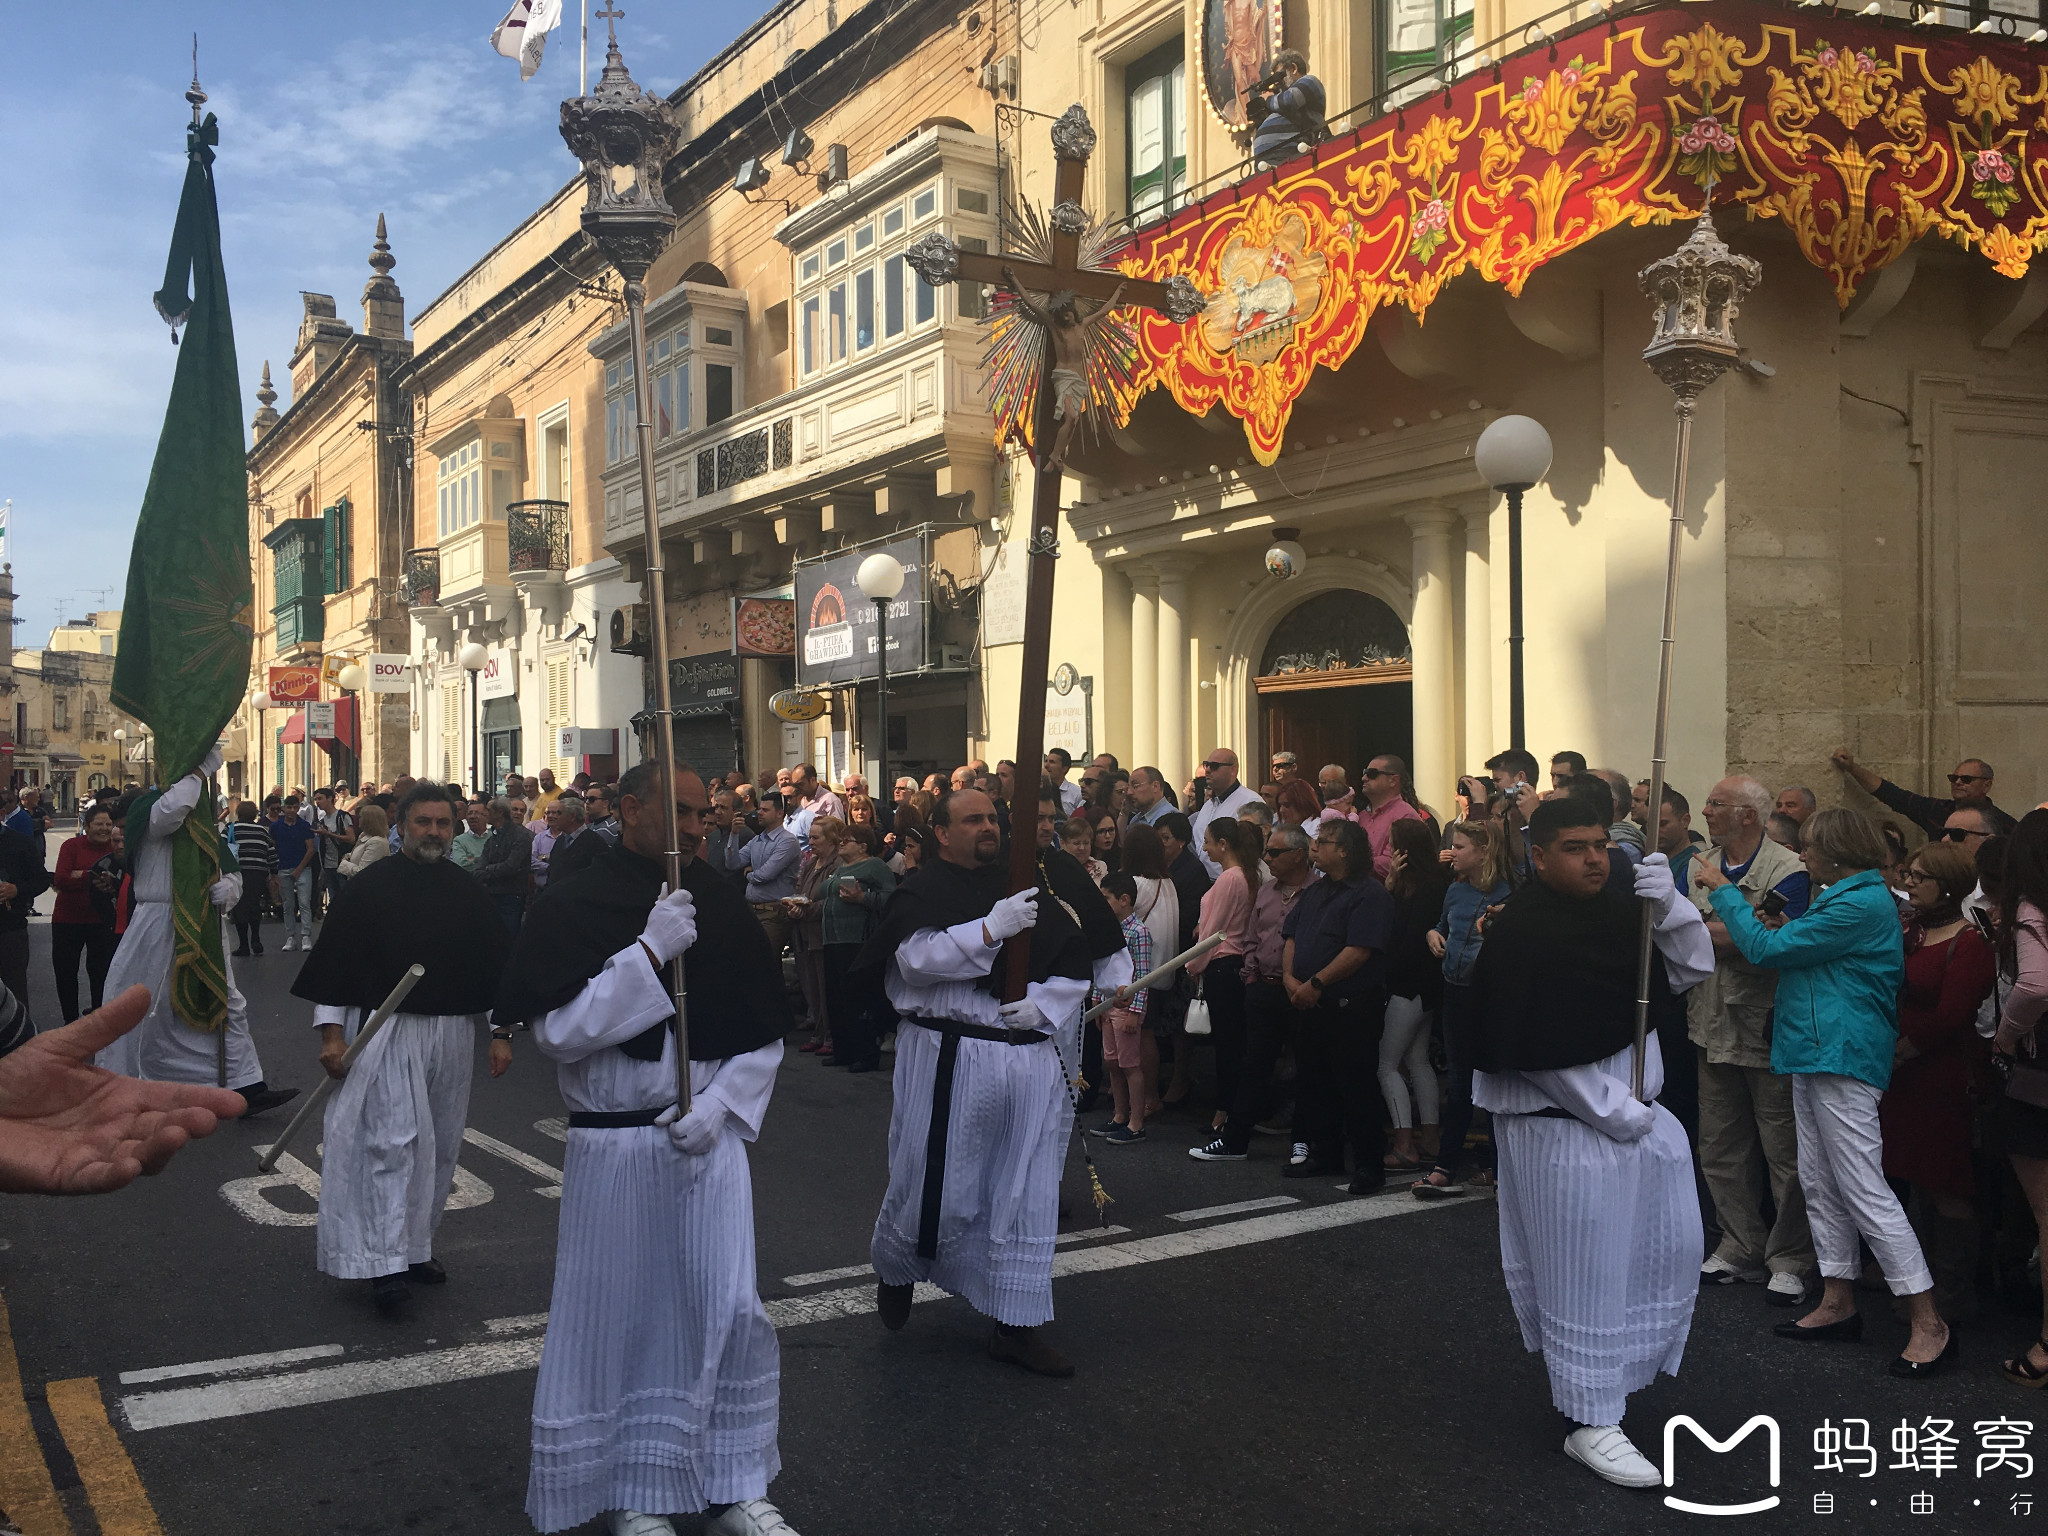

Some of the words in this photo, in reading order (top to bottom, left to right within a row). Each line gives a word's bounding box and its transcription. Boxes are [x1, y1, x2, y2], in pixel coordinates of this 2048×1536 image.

[889, 600, 911, 619] 2721
[375, 664, 404, 676] BOV
[275, 674, 315, 695] Kinnie
[706, 687, 733, 698] GOLDWELL
[562, 733, 573, 745] BOV
